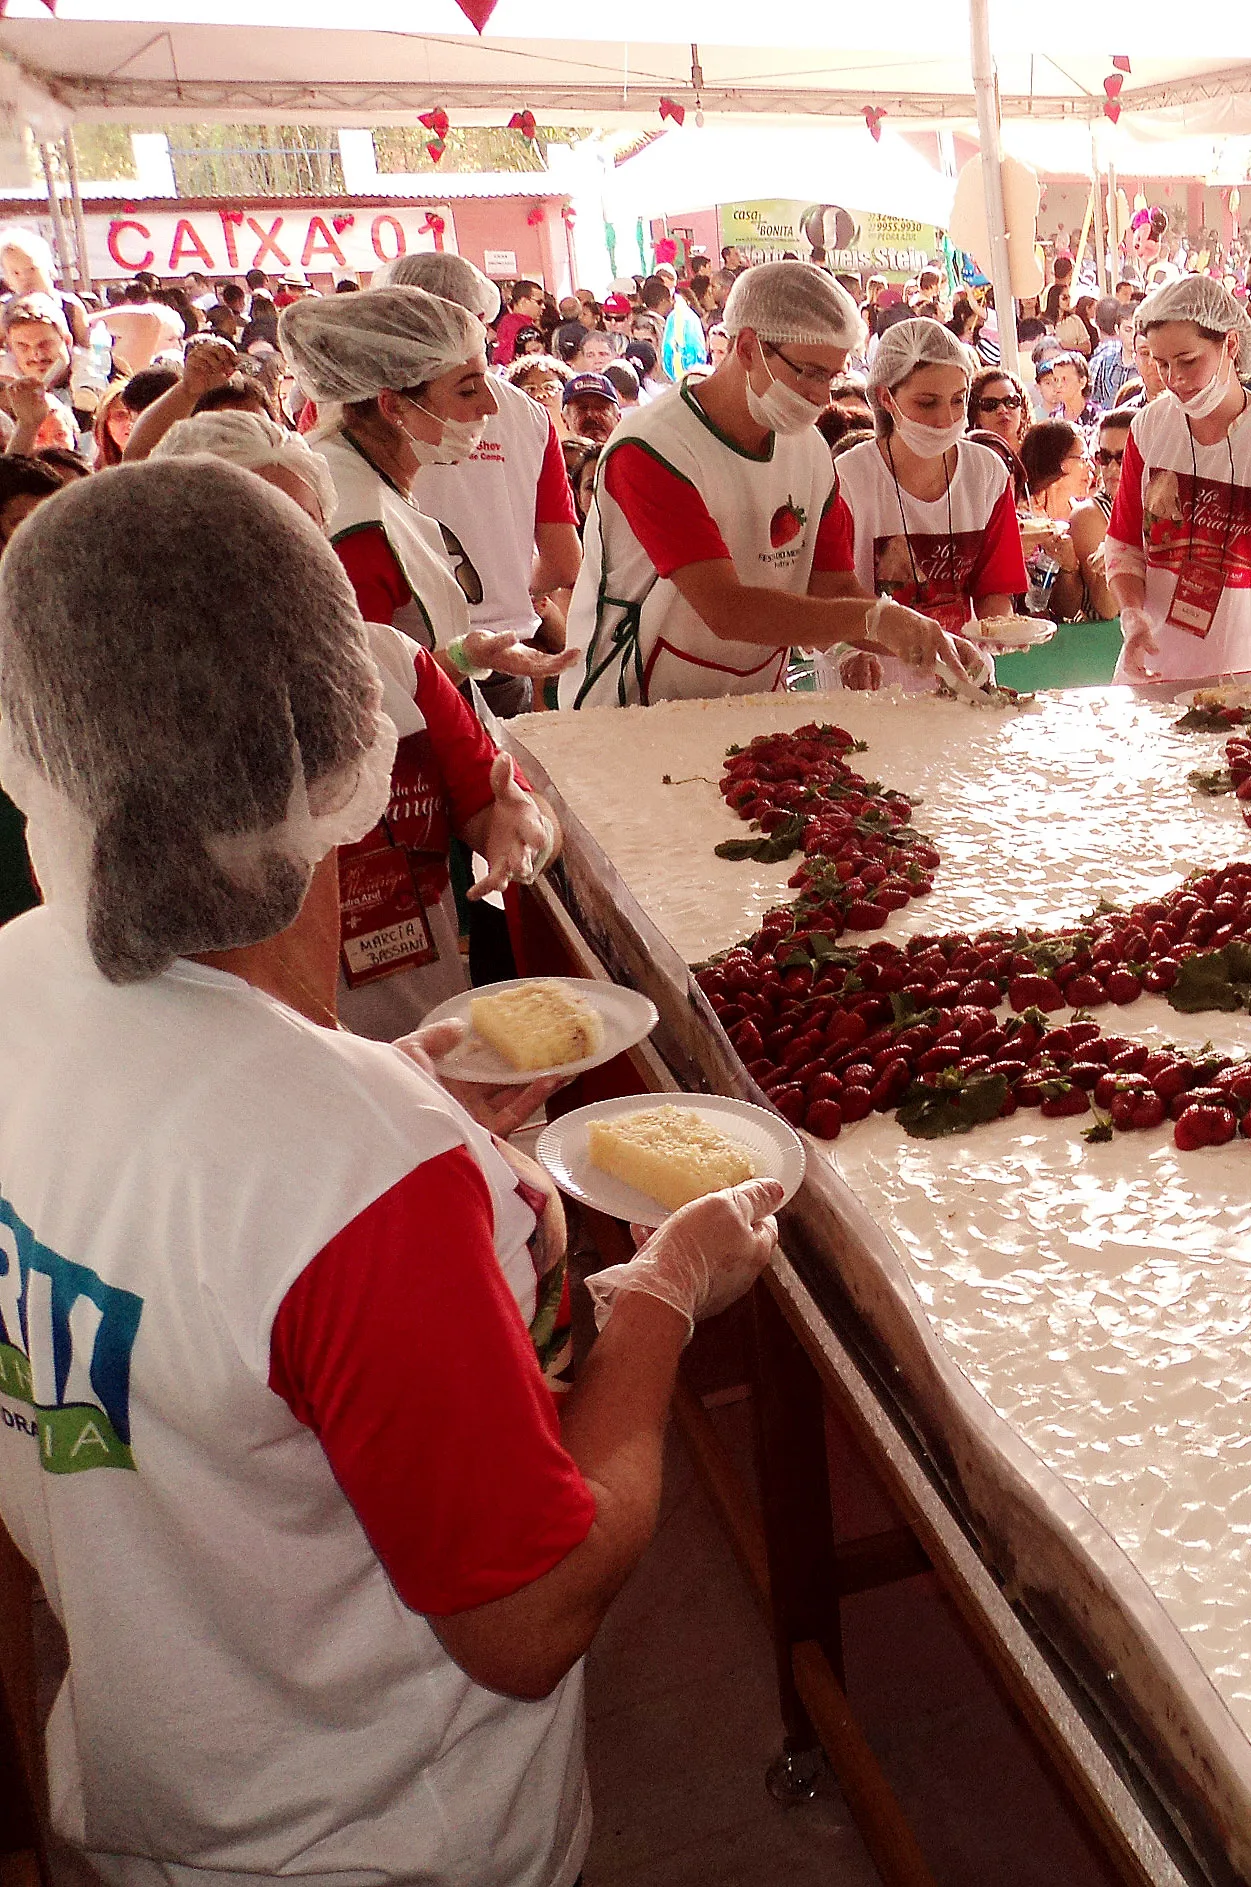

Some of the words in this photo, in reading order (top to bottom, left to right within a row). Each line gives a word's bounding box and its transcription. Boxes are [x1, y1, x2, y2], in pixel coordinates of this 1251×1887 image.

[733, 210, 758, 220] casa
[760, 225, 794, 237] BONITA
[877, 222, 922, 232] 9955.9930
[107, 209, 347, 271] CAIXA
[371, 211, 445, 264] 01
[875, 248, 928, 270] Stein
